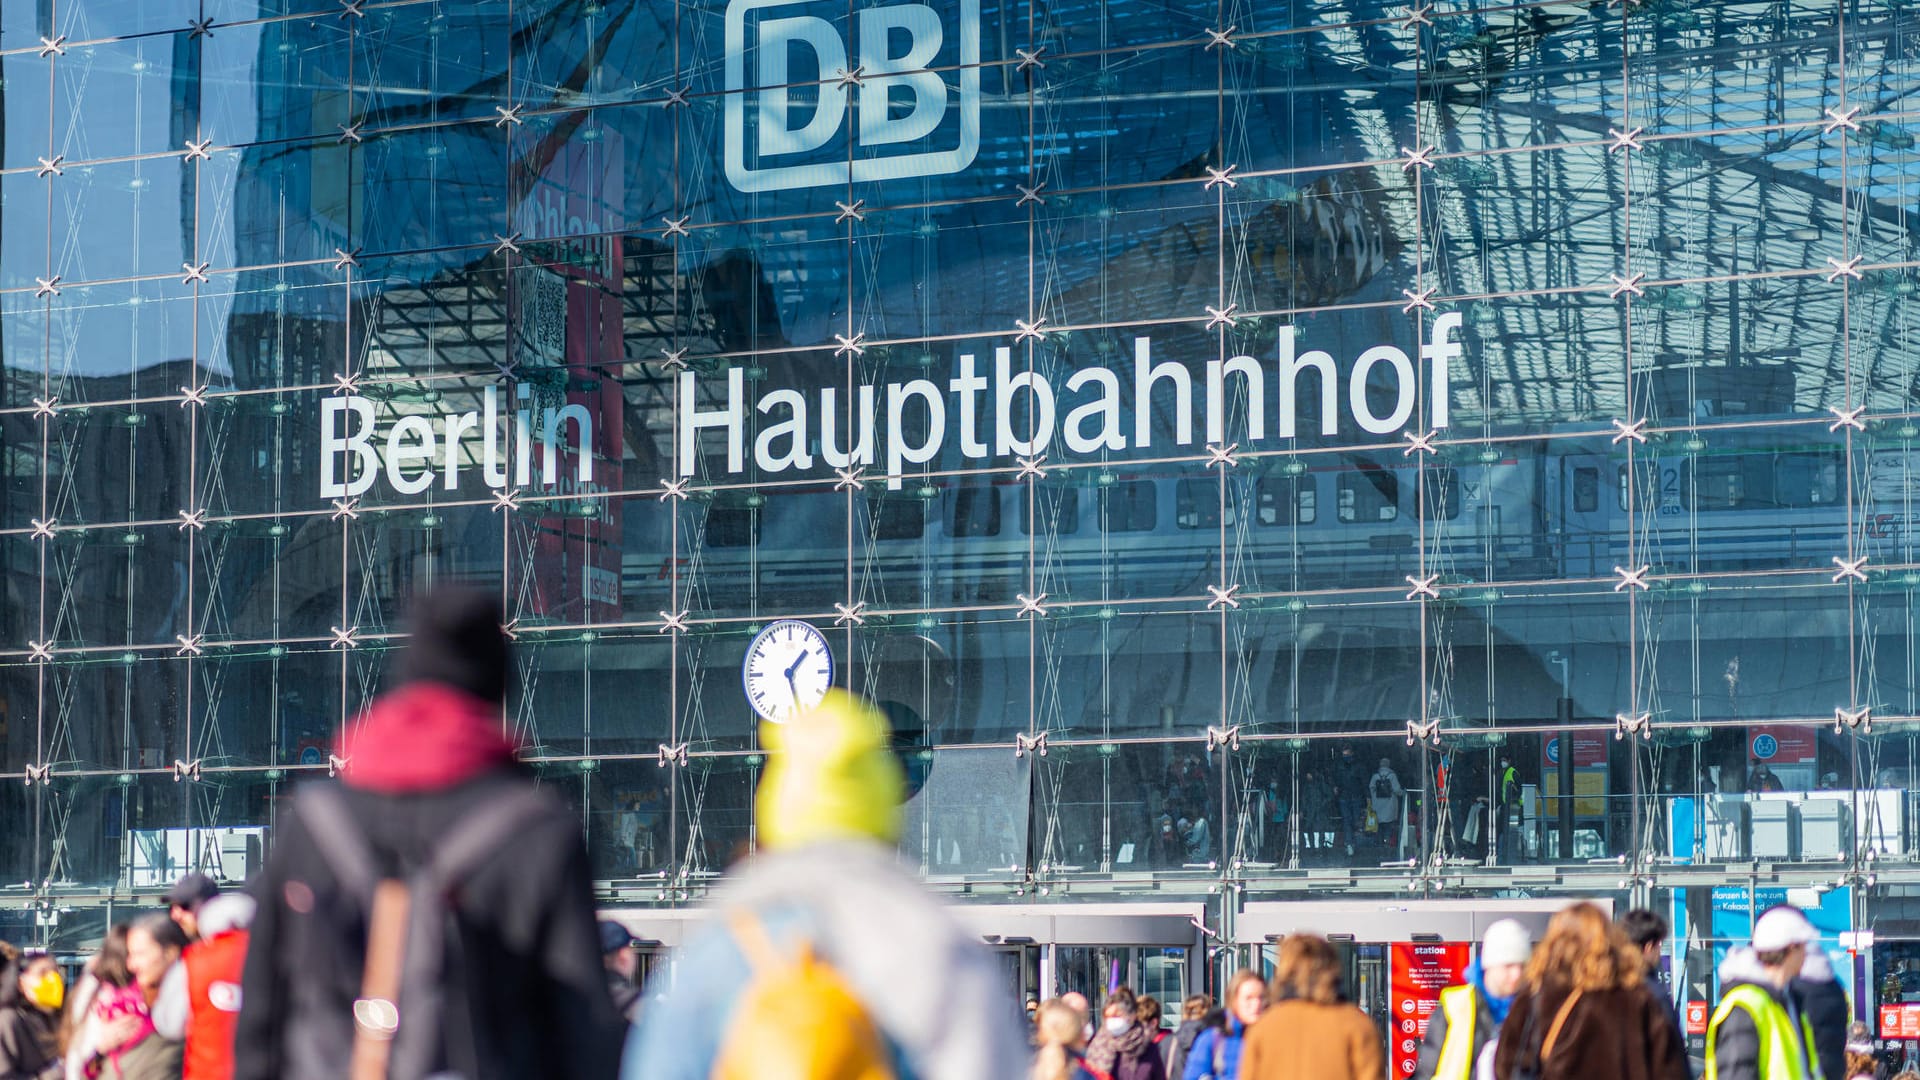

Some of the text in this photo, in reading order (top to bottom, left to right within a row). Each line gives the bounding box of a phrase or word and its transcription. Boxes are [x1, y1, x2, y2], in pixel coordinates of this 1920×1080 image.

[758, 3, 948, 157] DB
[320, 312, 1463, 499] Berlin Hauptbahnhof
[1663, 467, 1679, 492] 2
[1414, 946, 1446, 955] station
